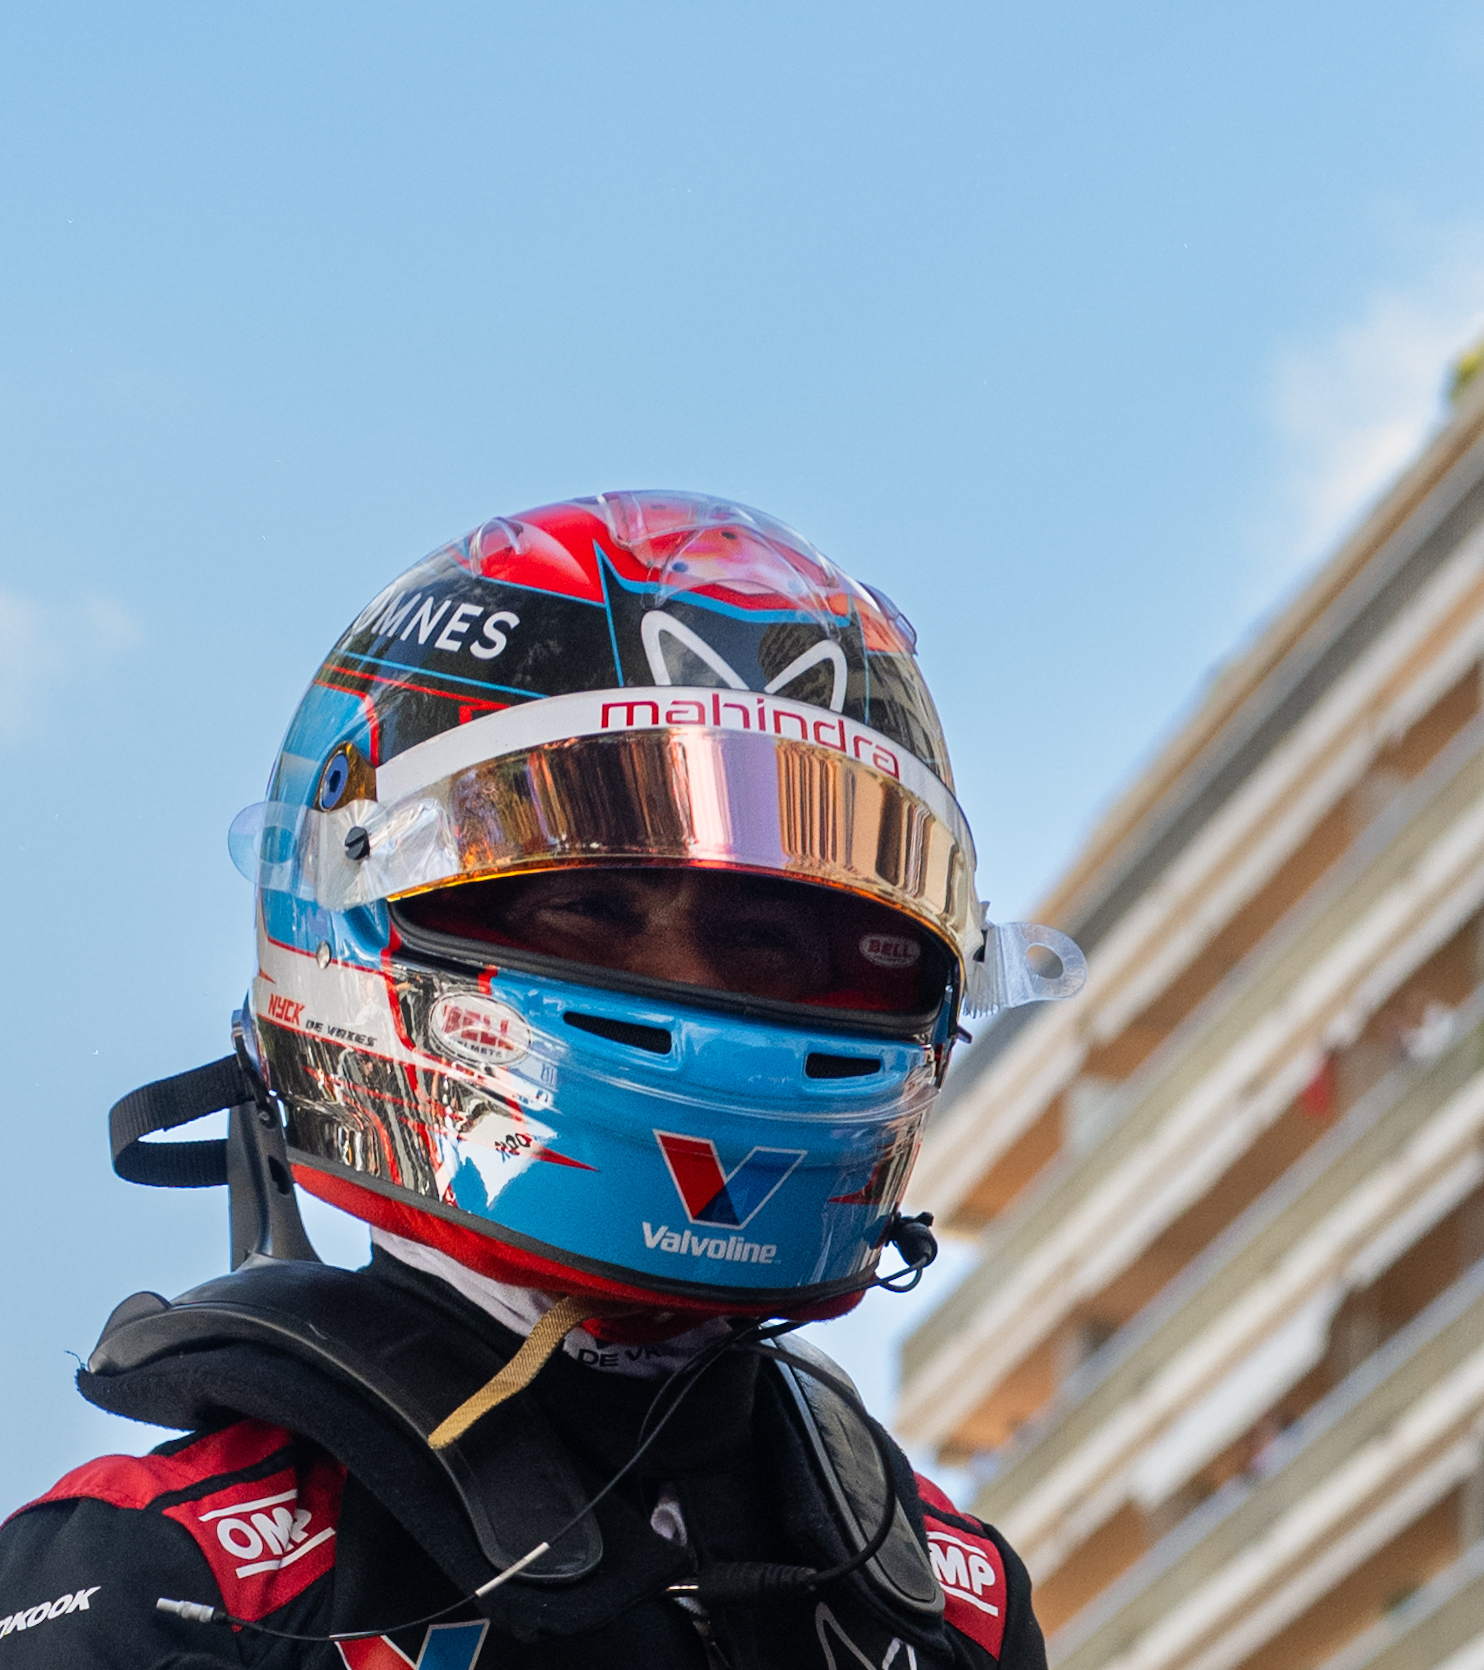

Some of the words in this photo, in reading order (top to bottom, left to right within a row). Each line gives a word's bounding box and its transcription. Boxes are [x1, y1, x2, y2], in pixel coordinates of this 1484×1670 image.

[600, 693, 901, 781] mahindra
[268, 994, 305, 1026] NYCK
[642, 1221, 778, 1264] Valvoline
[218, 1508, 312, 1560] OMP
[928, 1541, 995, 1596] MP
